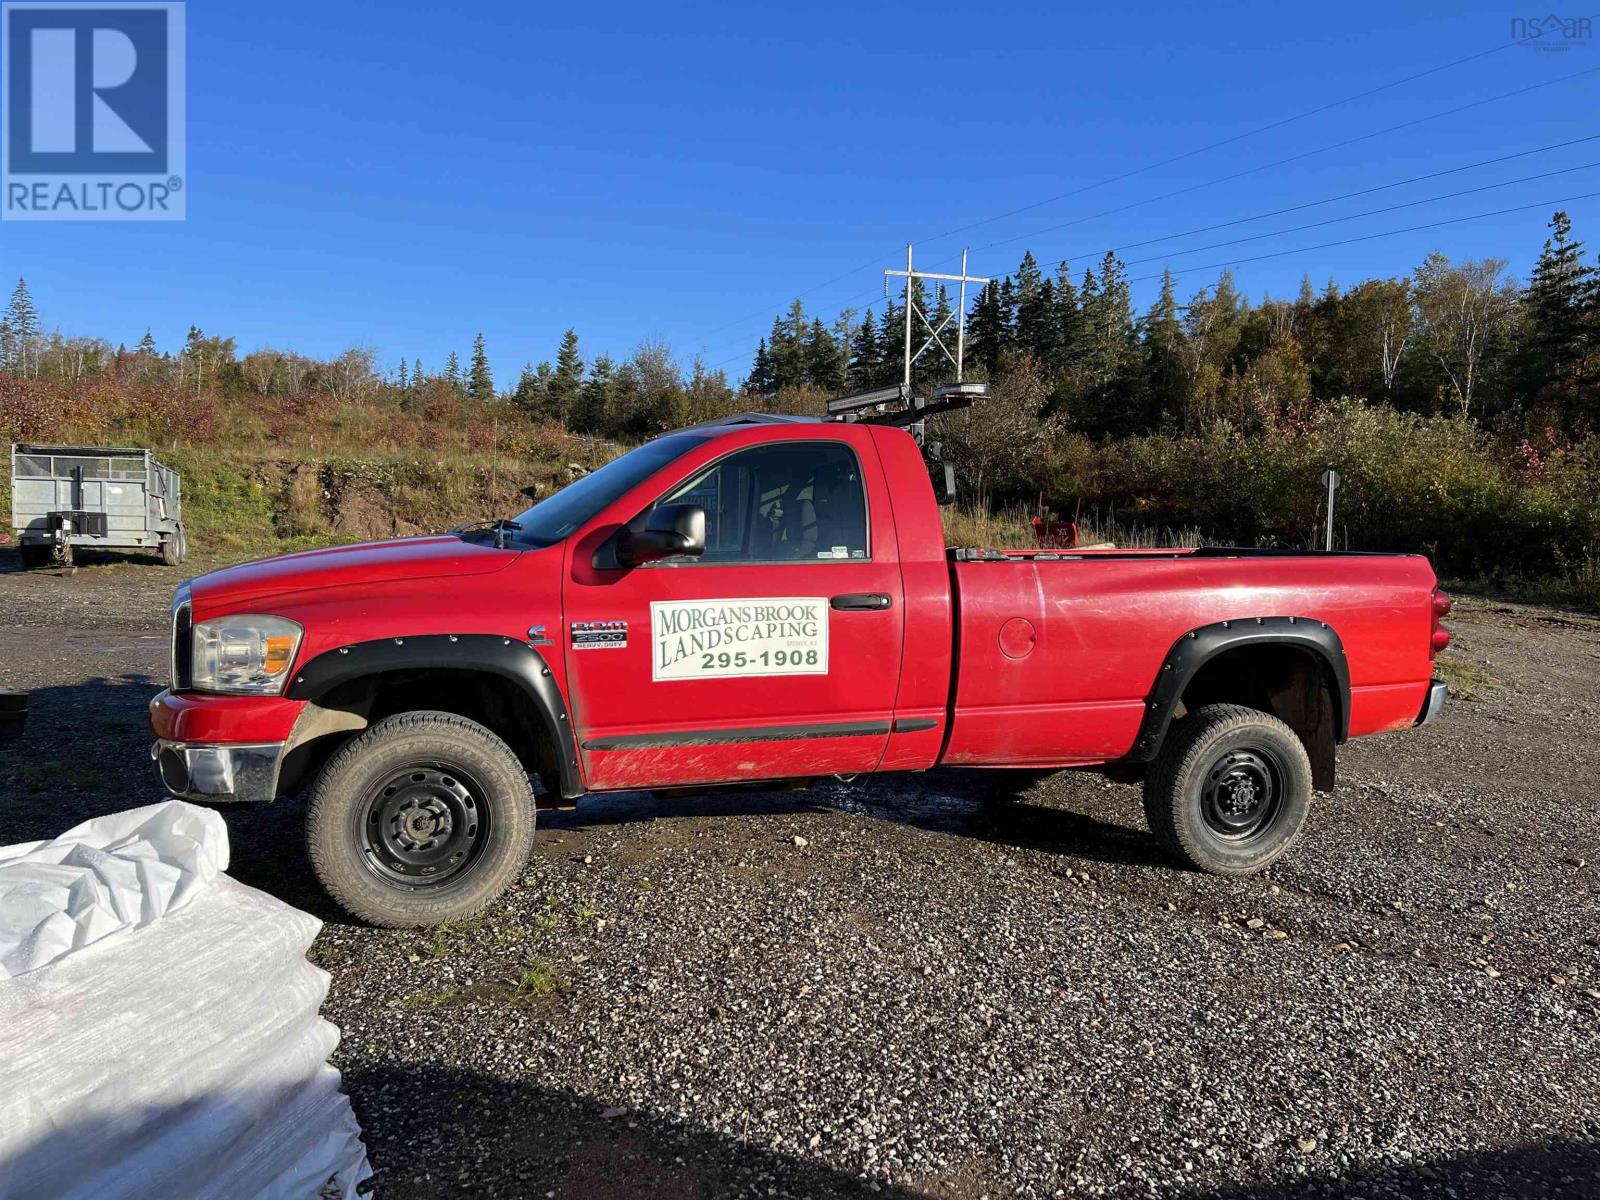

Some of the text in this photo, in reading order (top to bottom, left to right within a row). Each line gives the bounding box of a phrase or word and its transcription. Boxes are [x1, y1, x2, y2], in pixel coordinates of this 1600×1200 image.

[659, 605, 819, 637] MORGANS BROOK
[575, 633, 623, 643] 2500
[660, 621, 818, 670] LANDSCAPING
[701, 650, 819, 669] 295-1908
